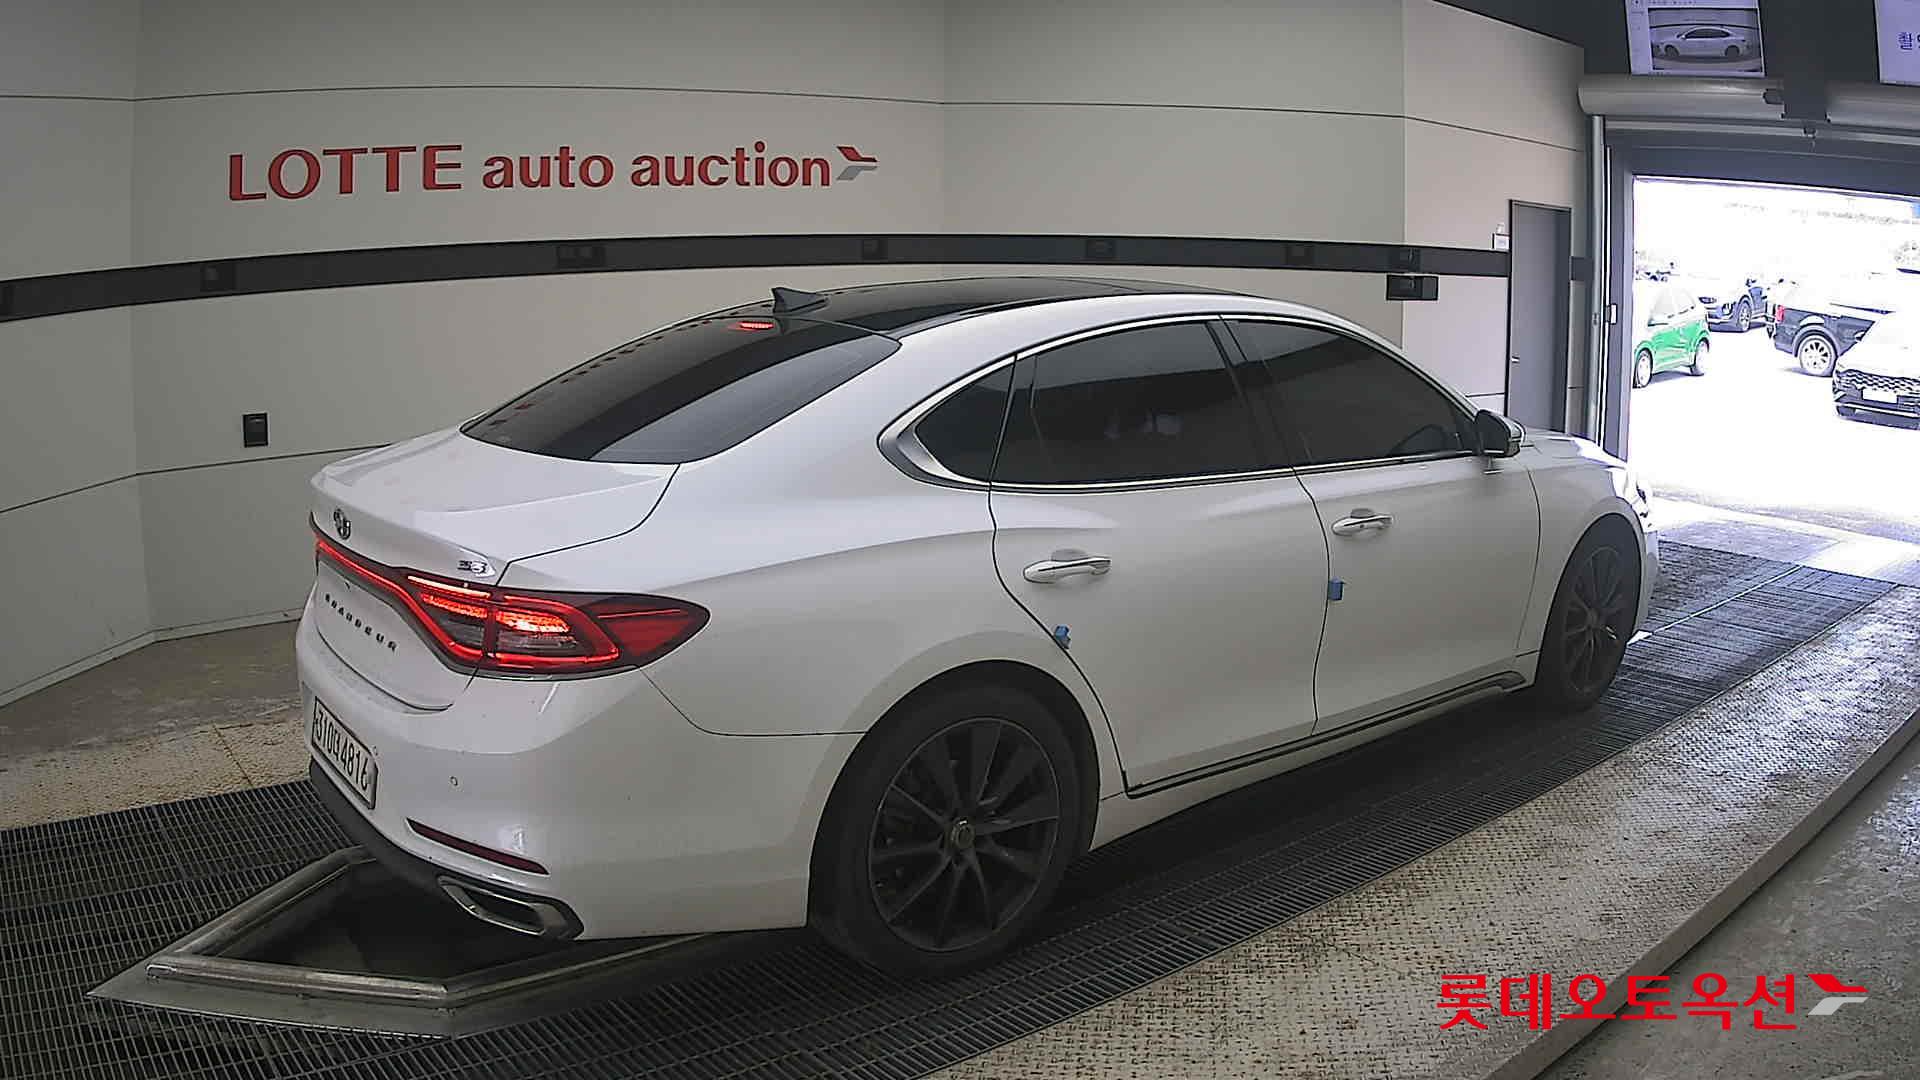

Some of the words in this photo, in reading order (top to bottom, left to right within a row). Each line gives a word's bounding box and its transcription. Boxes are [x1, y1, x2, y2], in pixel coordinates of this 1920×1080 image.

[229, 145, 462, 201] LOTTE
[482, 147, 613, 189] auto
[630, 141, 830, 188] auction
